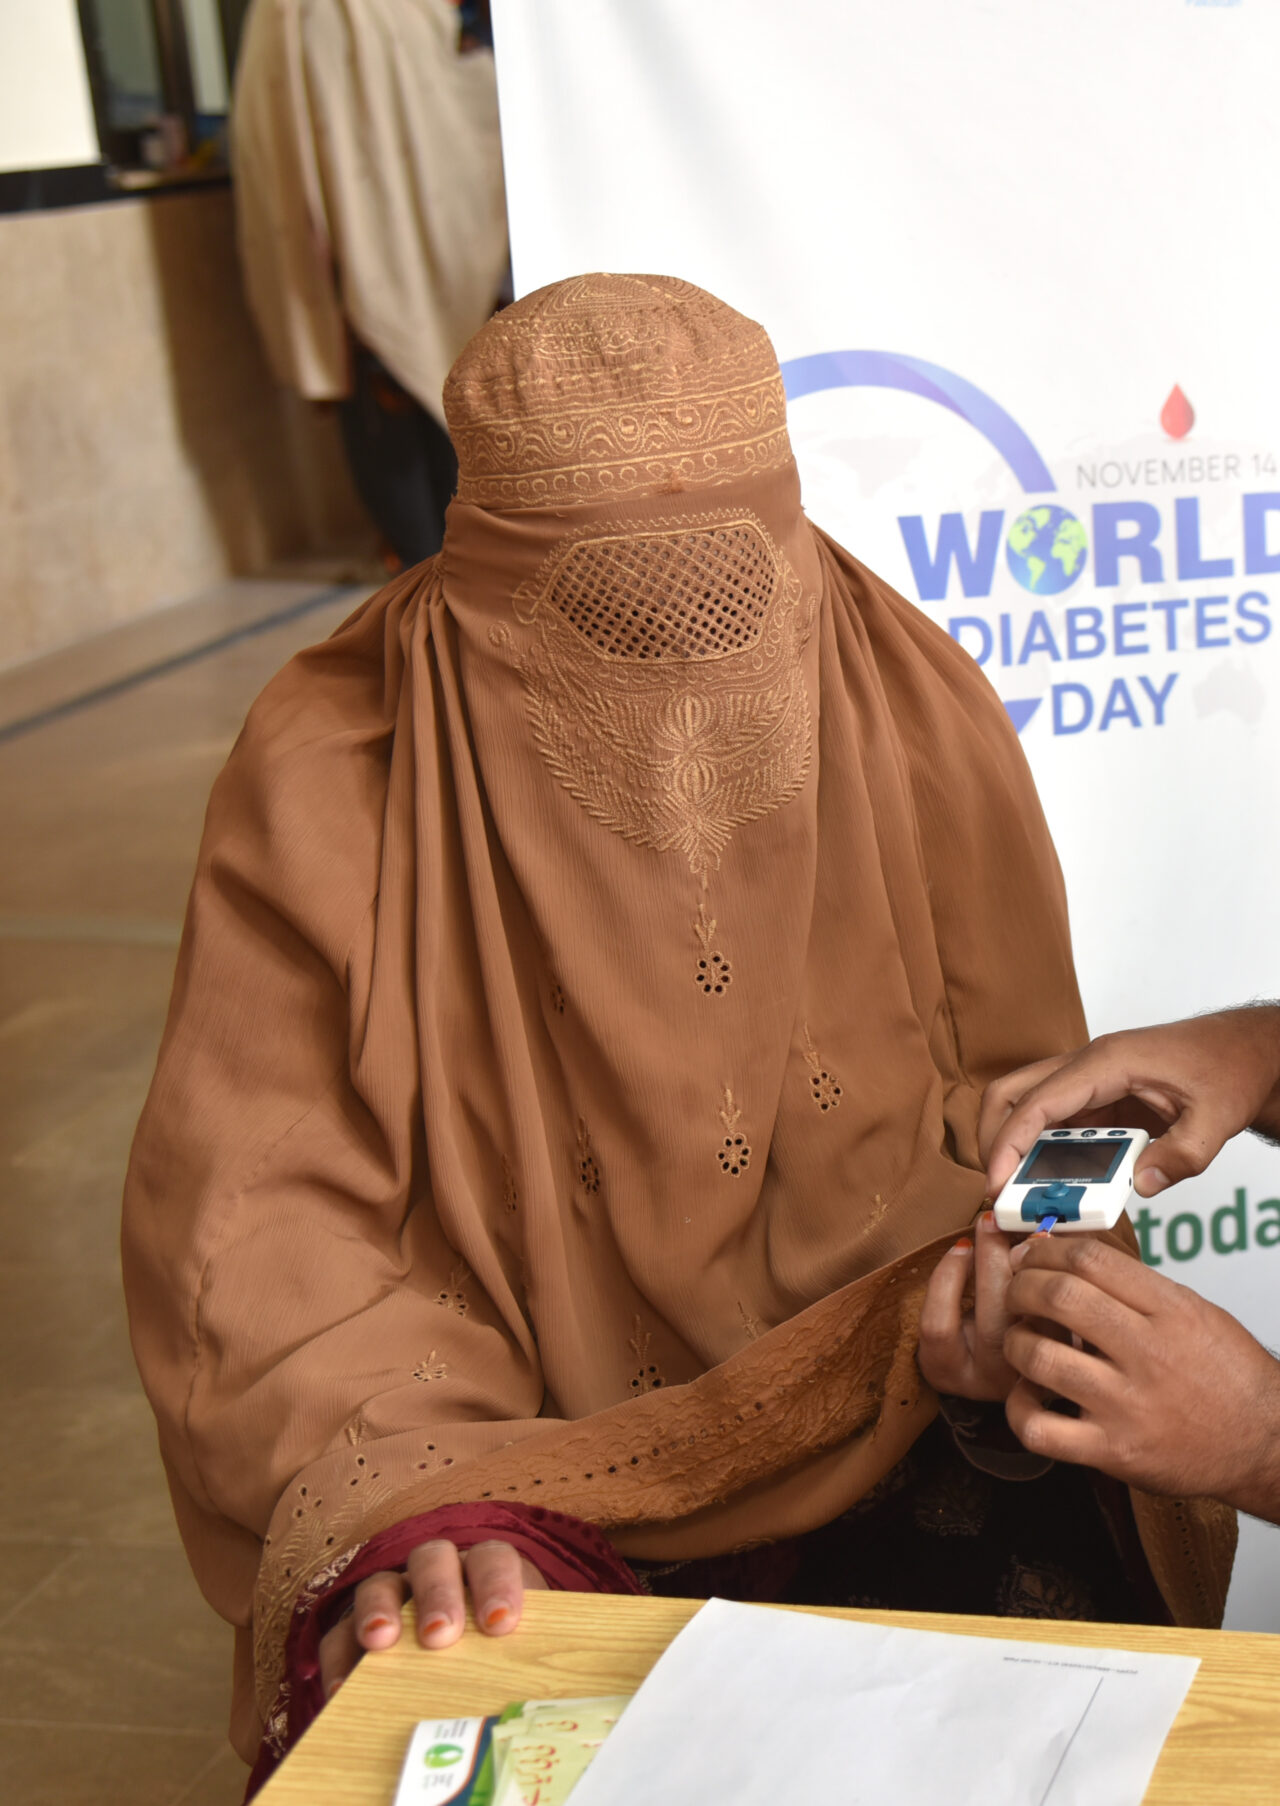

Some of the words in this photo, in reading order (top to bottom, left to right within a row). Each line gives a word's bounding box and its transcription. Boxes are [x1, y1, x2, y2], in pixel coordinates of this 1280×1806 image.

[1076, 454, 1242, 489] NOVEMBER
[1251, 453, 1278, 477] 14
[948, 591, 1273, 667] DIABETES
[1051, 673, 1179, 736] DAY
